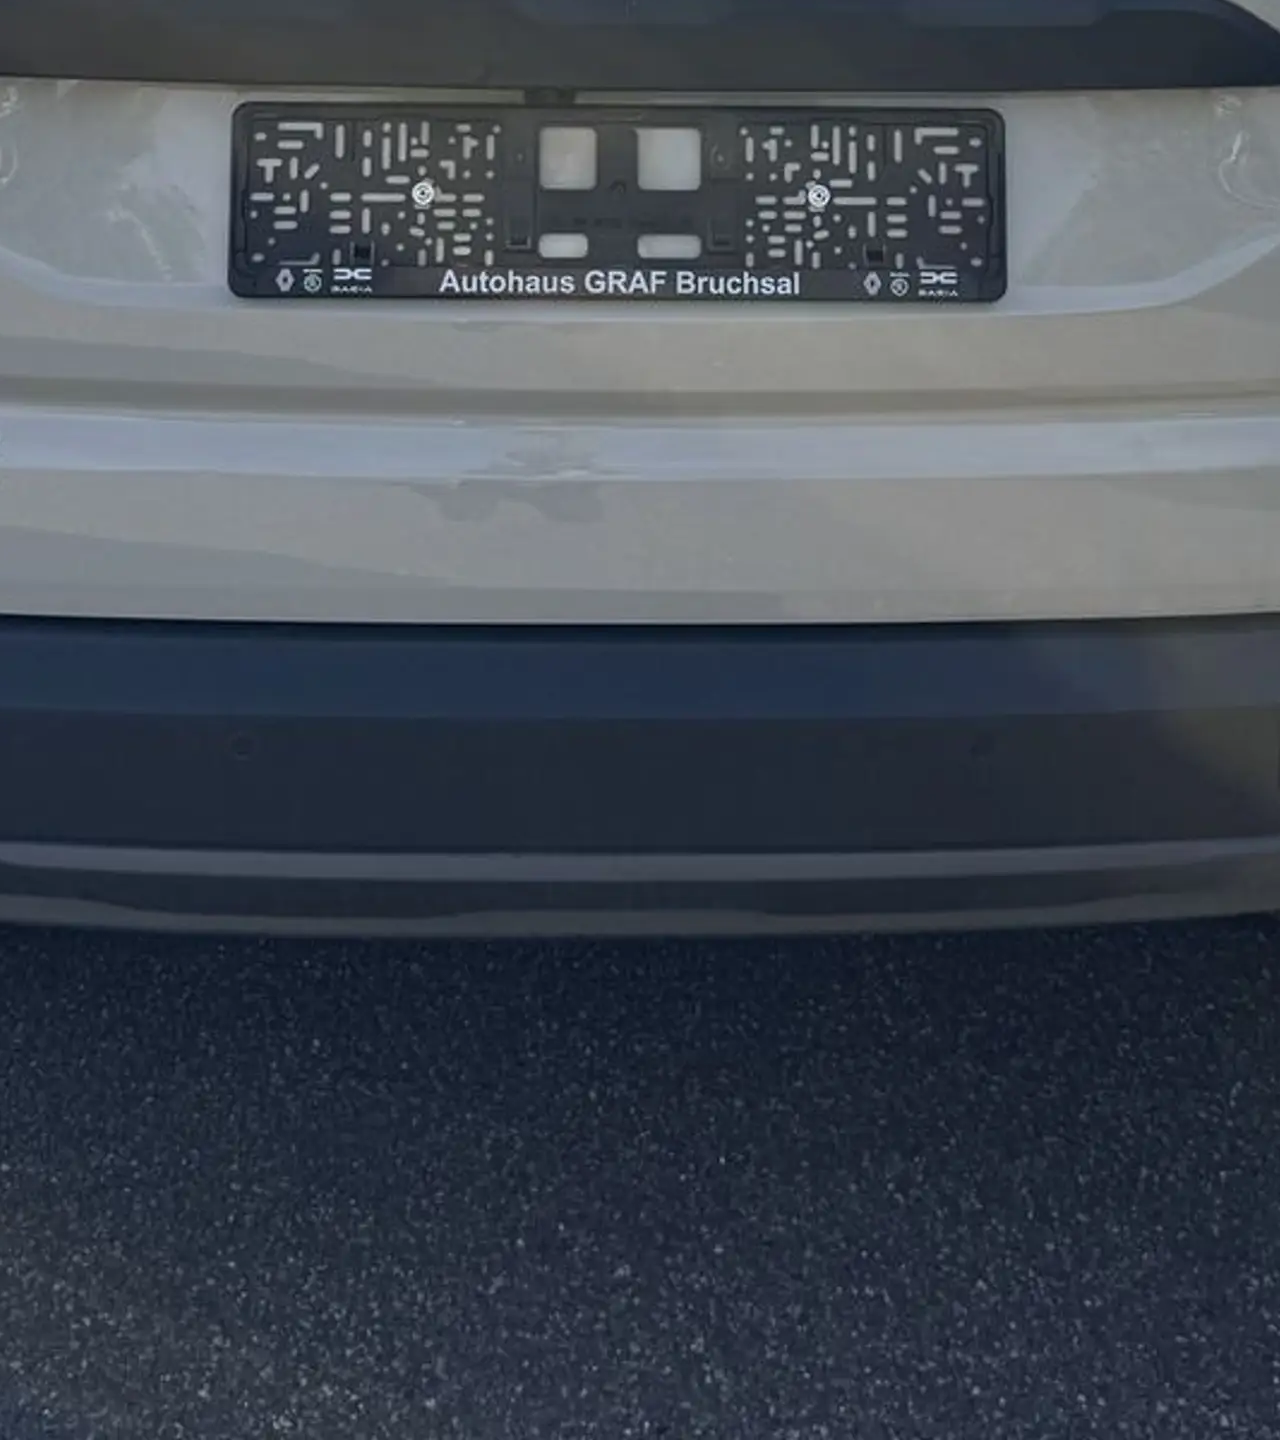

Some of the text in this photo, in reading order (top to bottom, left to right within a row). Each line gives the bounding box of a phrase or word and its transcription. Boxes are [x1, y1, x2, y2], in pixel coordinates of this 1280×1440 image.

[439, 269, 800, 296] Autohaus GRAF Bruchsal
